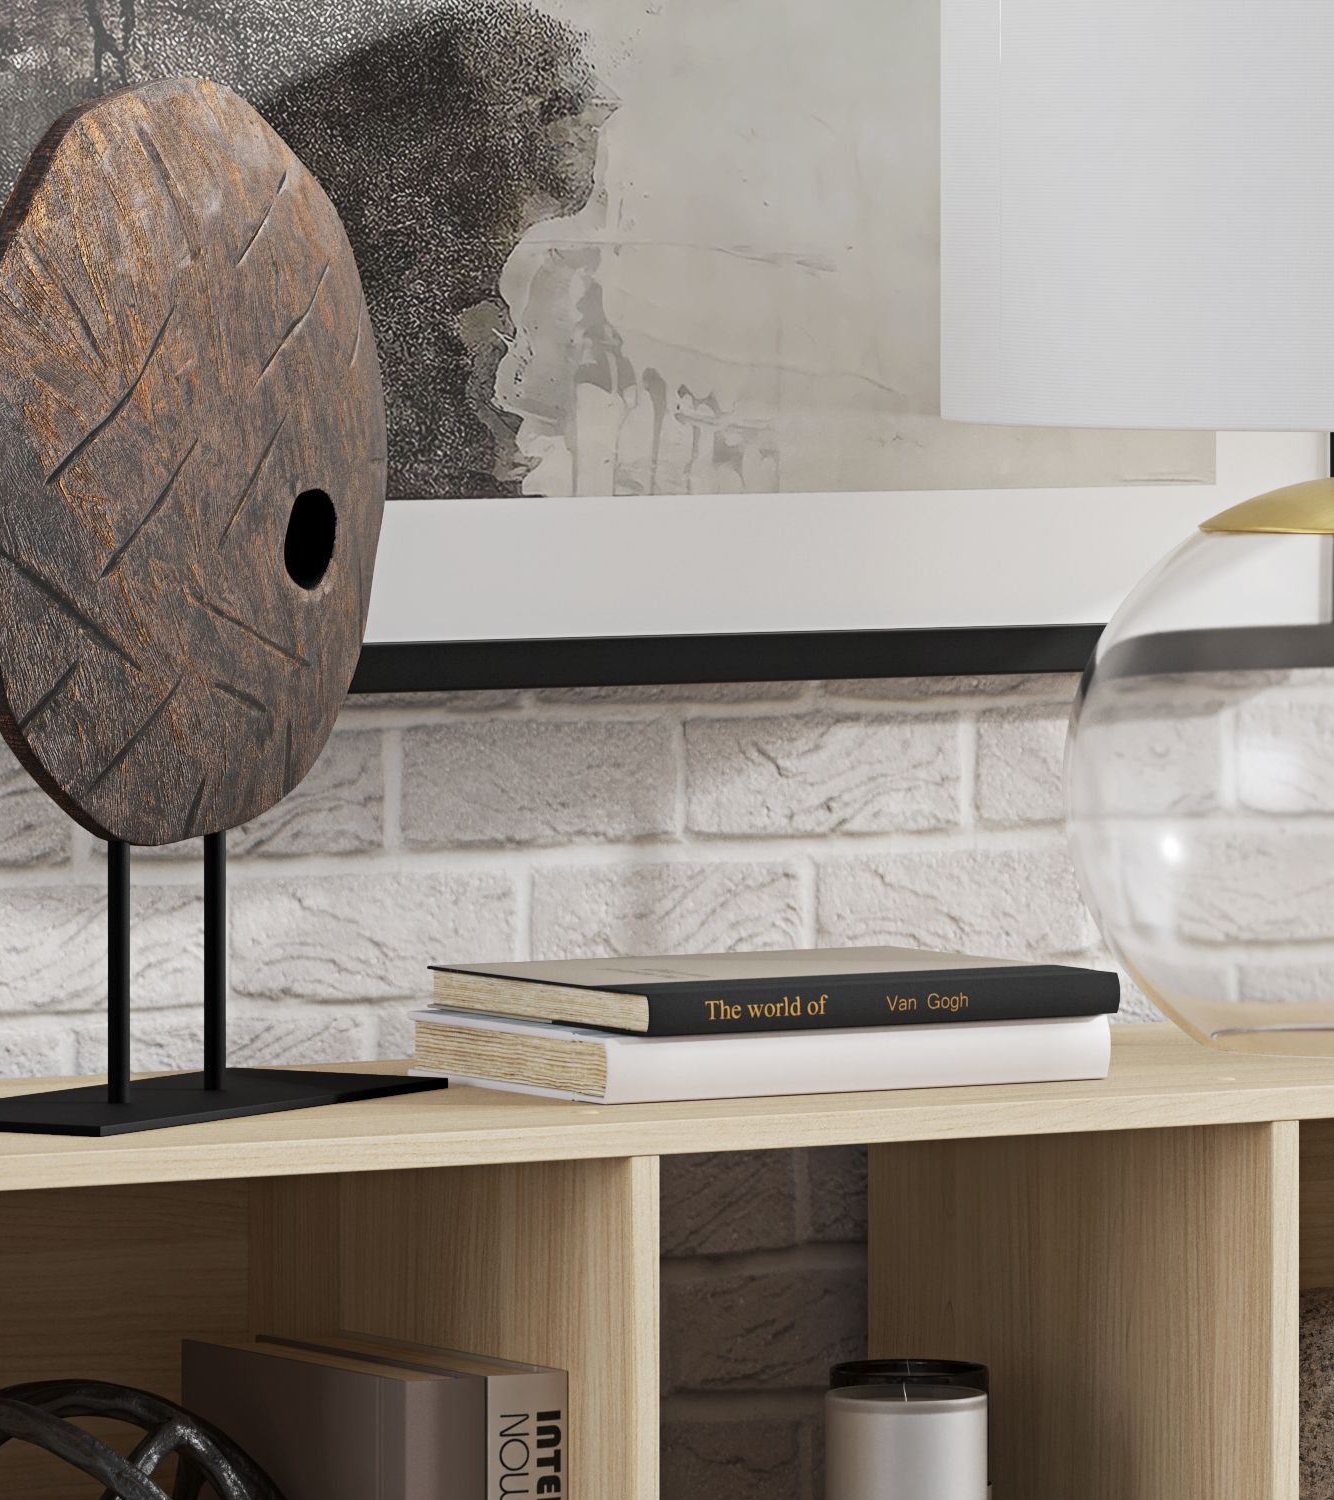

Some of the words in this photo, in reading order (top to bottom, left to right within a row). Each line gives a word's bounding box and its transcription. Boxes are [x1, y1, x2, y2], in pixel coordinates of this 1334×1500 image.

[705, 1000, 741, 1020] The
[747, 996, 801, 1017] world
[807, 994, 828, 1015] of
[886, 995, 916, 1012] Van
[927, 992, 969, 1012] Gogh
